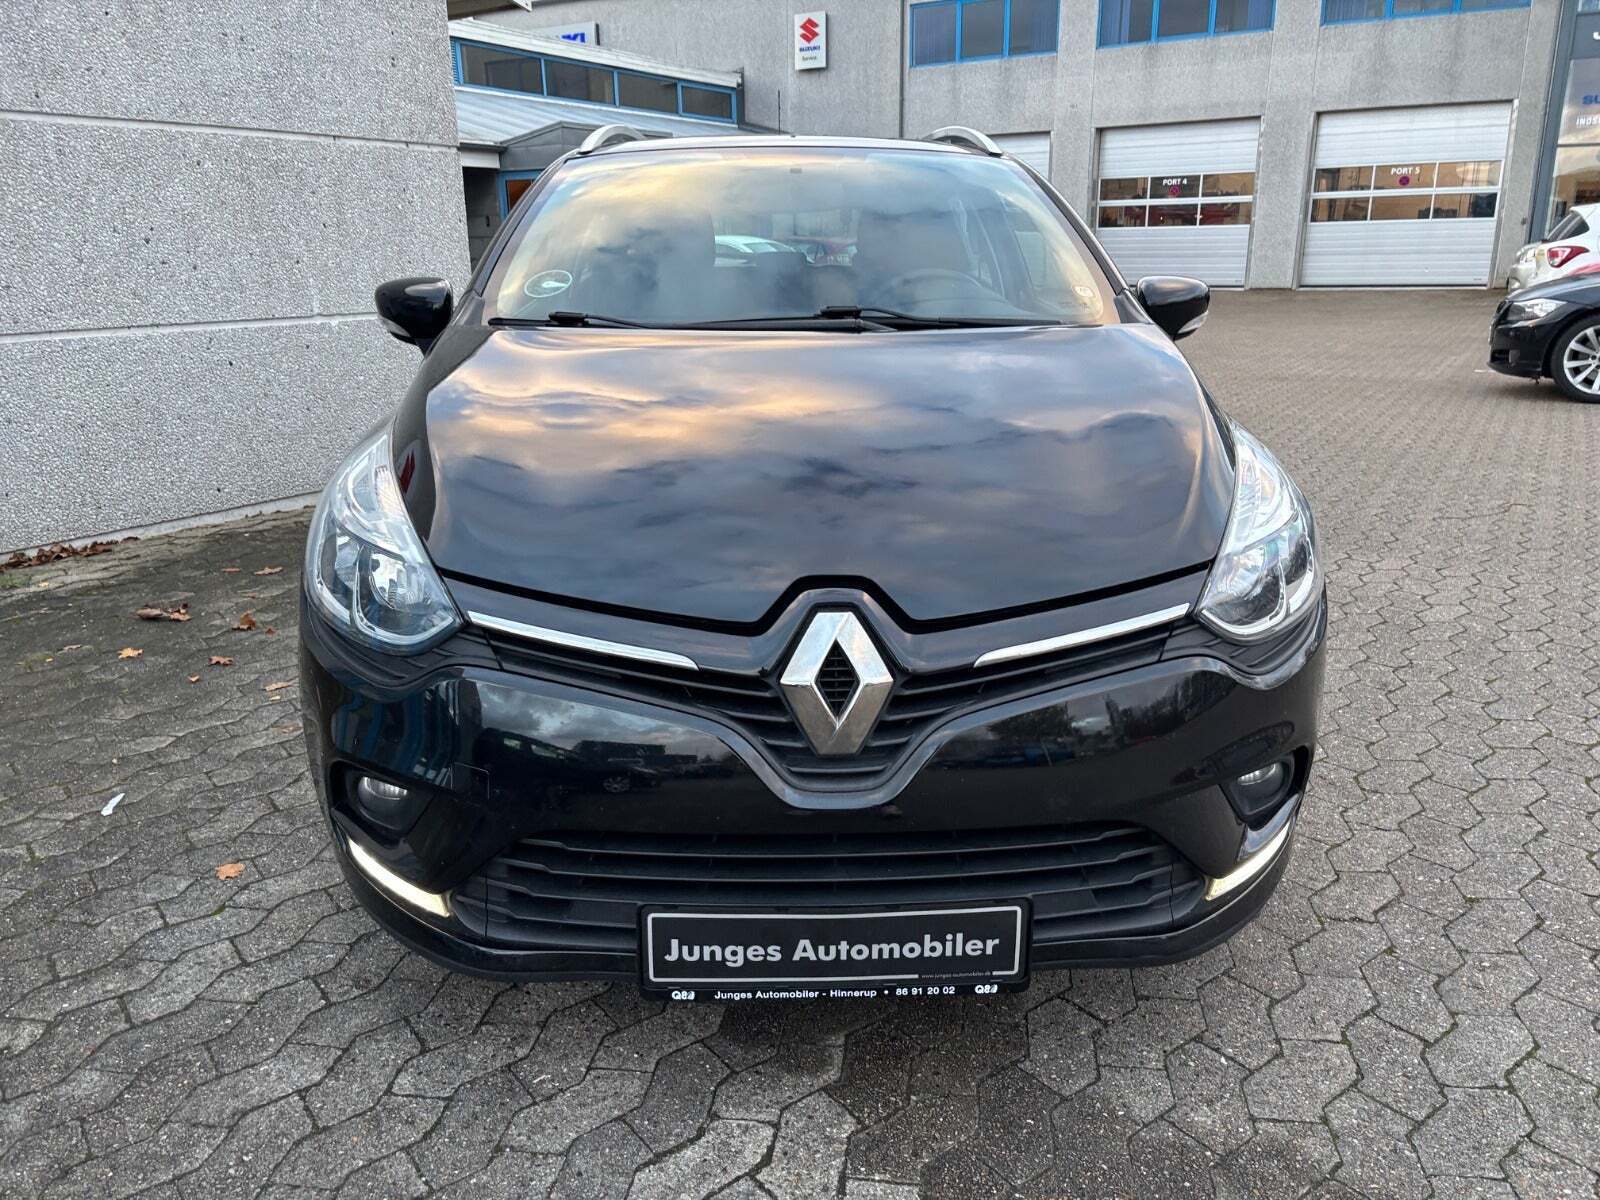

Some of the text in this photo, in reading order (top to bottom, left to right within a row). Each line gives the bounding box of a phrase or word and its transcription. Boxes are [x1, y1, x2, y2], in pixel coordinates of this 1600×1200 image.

[1390, 166, 1420, 175] PORT 5
[1162, 178, 1181, 186] PORT
[664, 932, 1000, 968] Junges Automobiler
[714, 991, 753, 1000] Junges
[755, 990, 819, 999] Automobiler
[830, 989, 877, 998] Hinnerup
[895, 988, 908, 996] 86
[911, 988, 923, 996] 91
[927, 987, 940, 995] 20
[942, 986, 956, 994] 02
